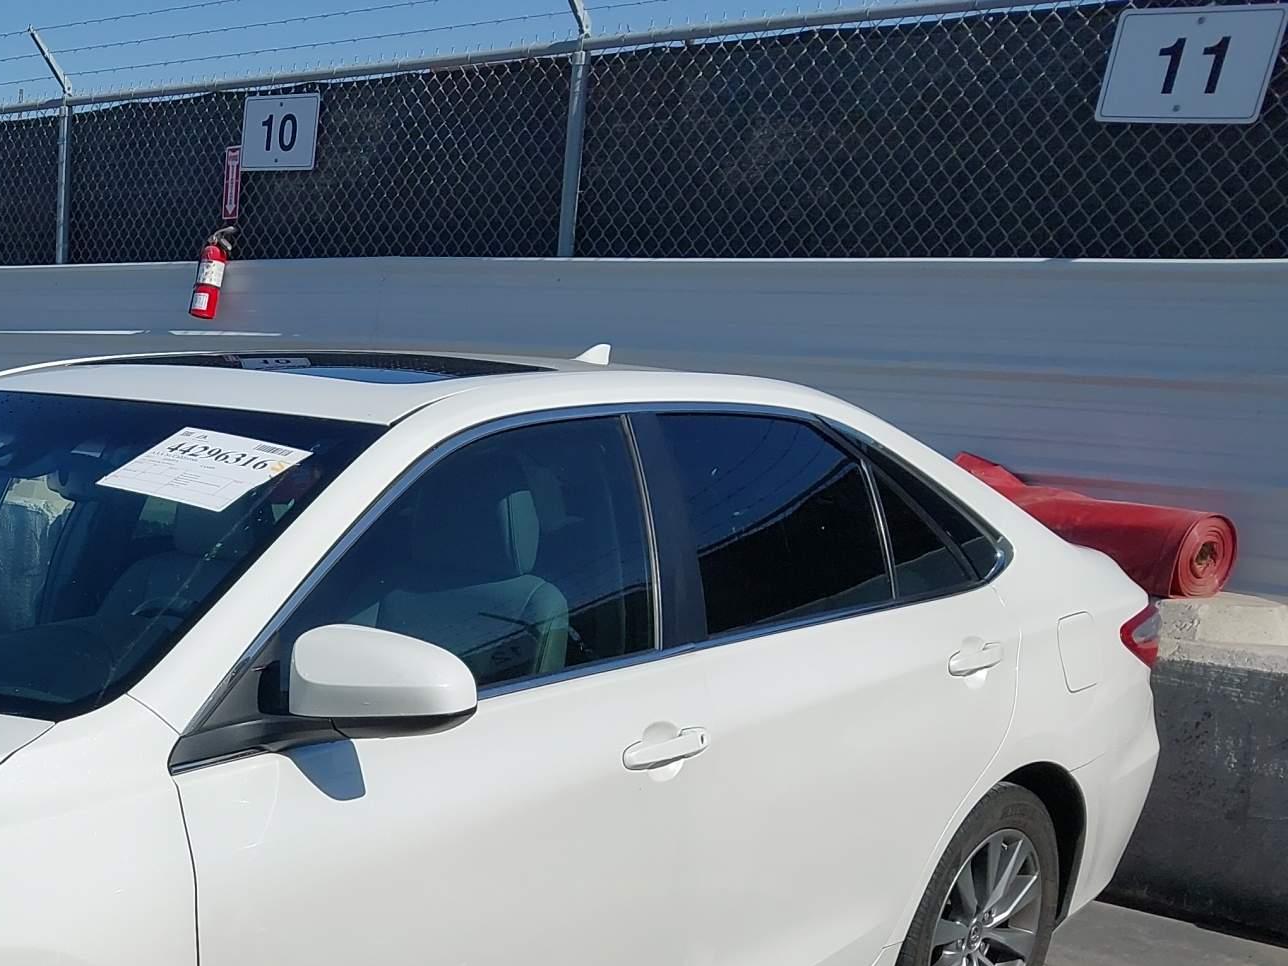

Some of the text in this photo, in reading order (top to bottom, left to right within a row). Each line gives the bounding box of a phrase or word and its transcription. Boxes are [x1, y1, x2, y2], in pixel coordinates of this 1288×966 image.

[1158, 35, 1232, 95] 11
[261, 113, 299, 152] 10
[166, 443, 269, 471] 44296316
